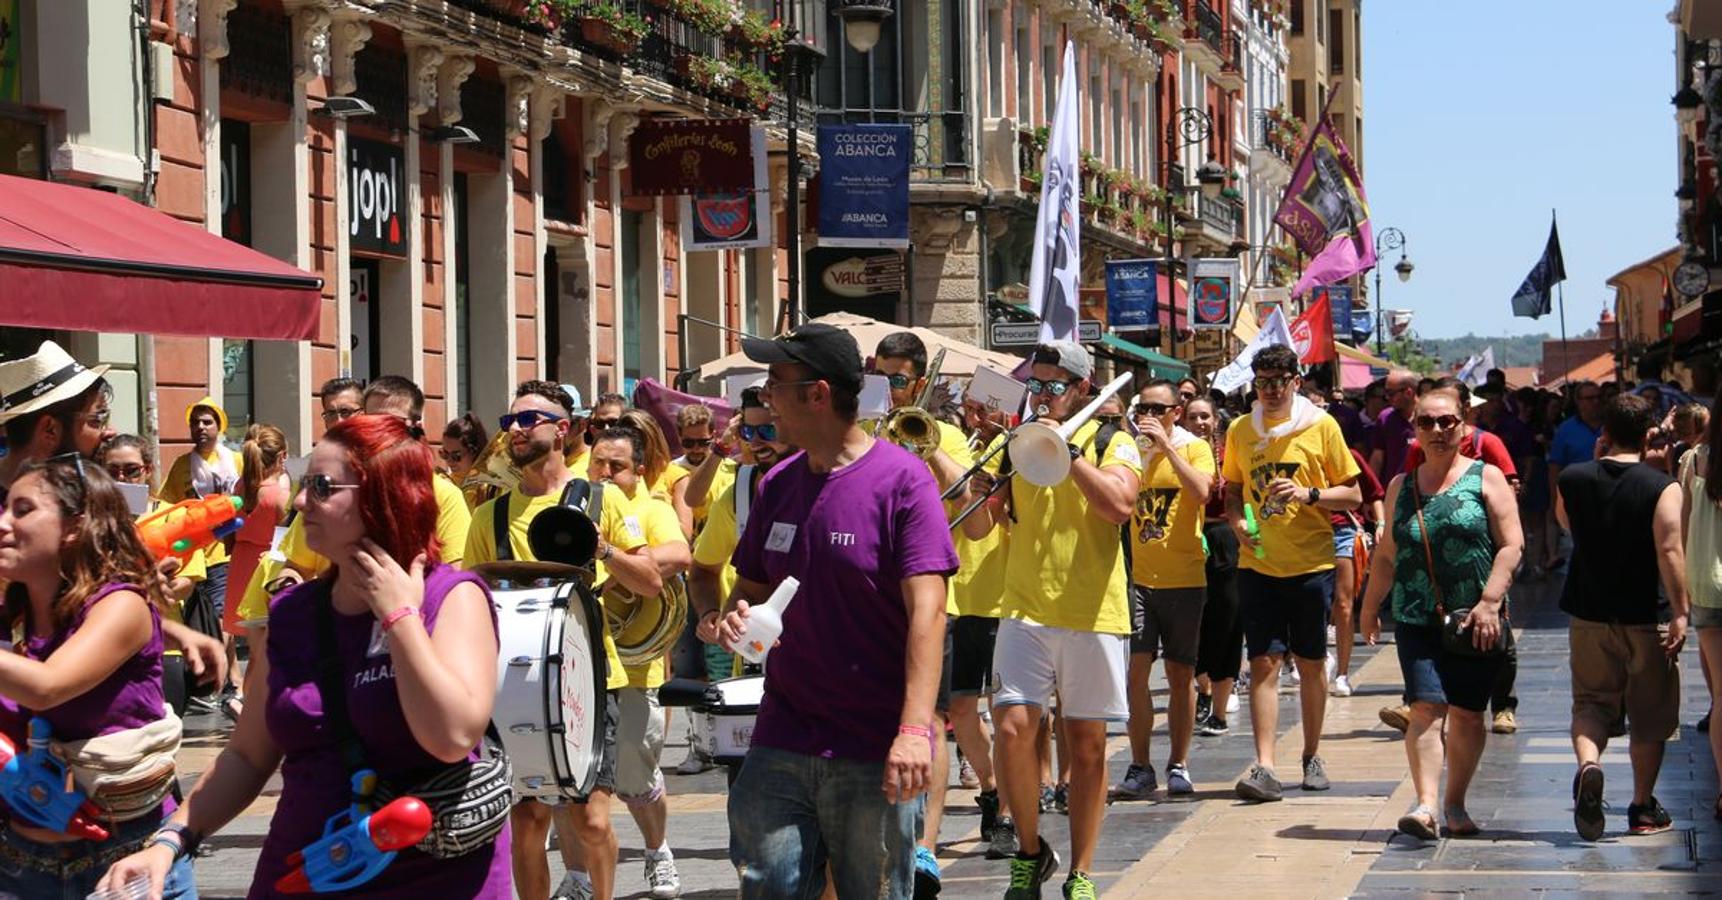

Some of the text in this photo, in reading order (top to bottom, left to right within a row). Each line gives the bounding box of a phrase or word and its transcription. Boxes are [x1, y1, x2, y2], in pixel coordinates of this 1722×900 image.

[835, 132, 897, 143] COLECCIÓN
[835, 144, 896, 156] ABANCA
[351, 149, 400, 244] jop!
[830, 532, 855, 546] FITI
